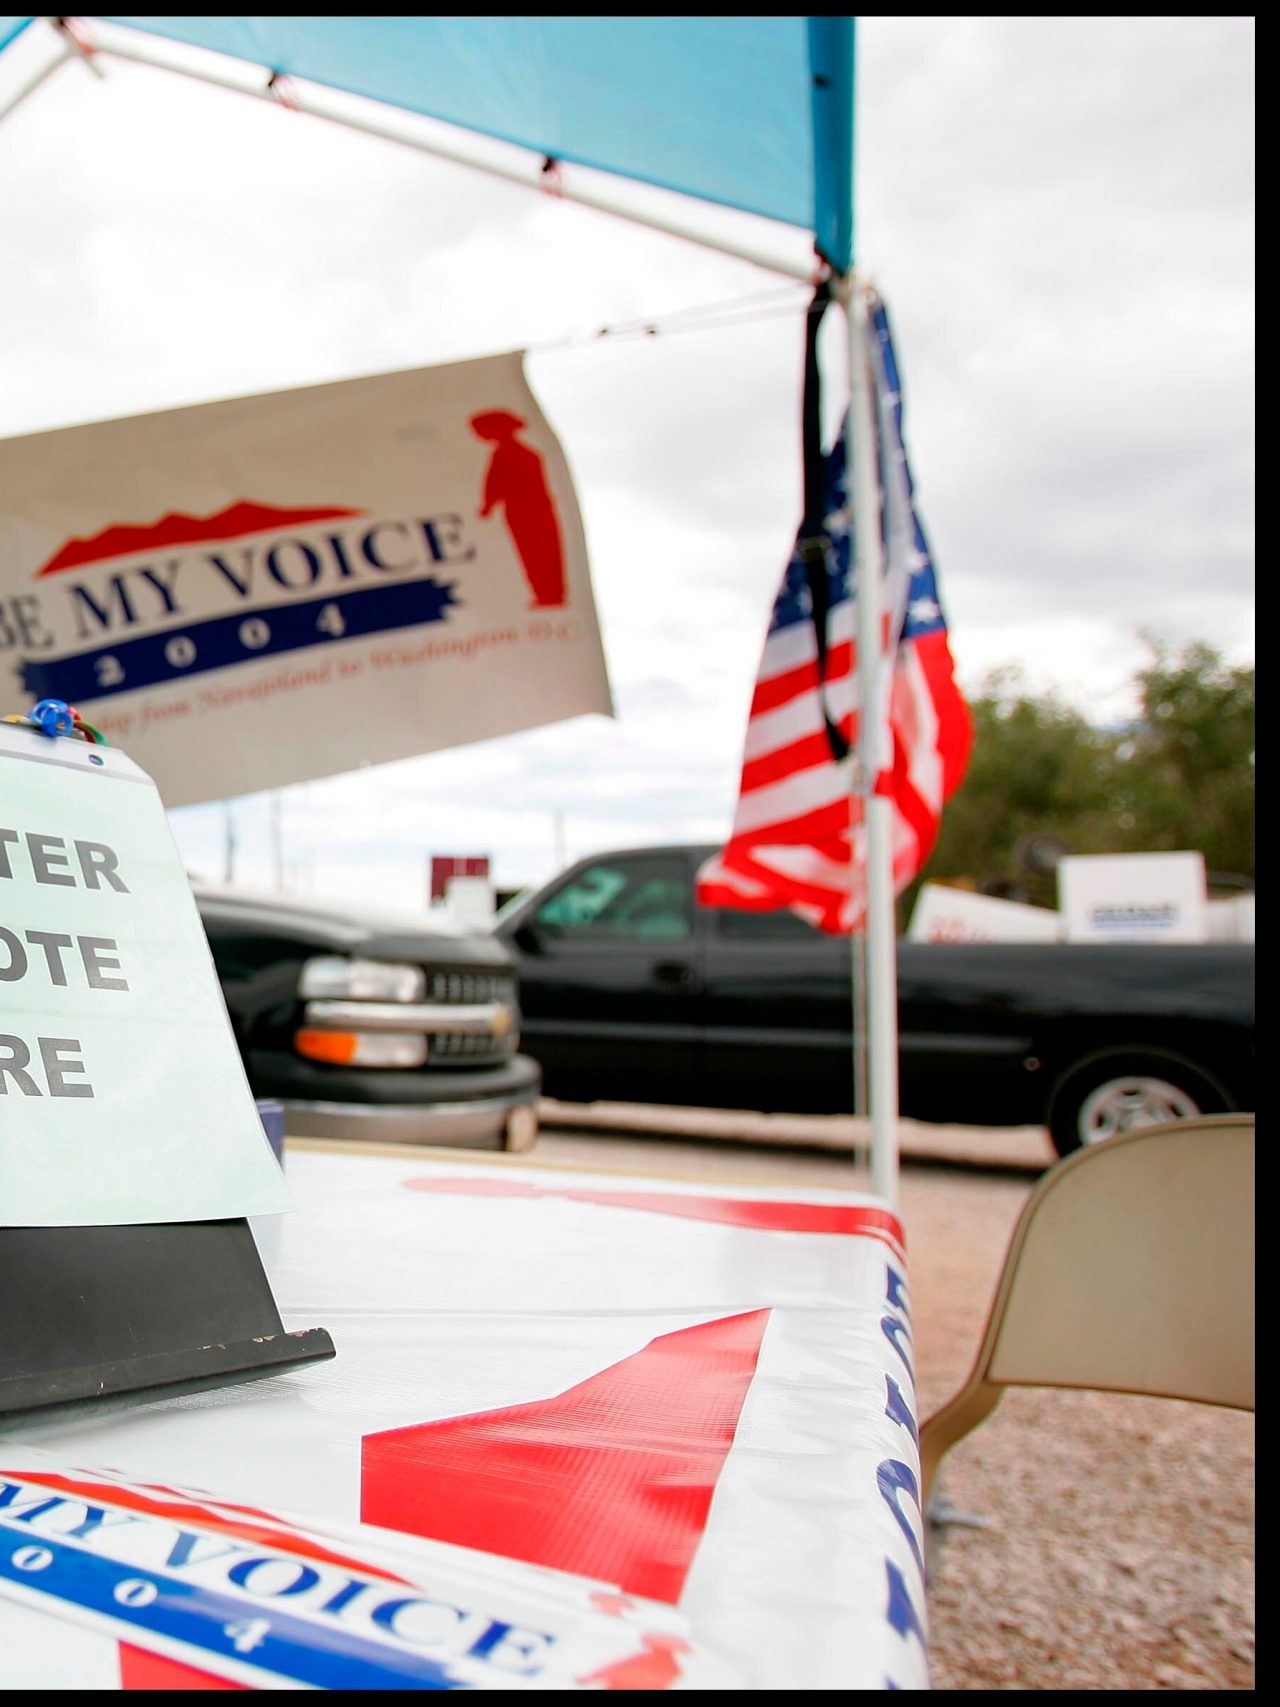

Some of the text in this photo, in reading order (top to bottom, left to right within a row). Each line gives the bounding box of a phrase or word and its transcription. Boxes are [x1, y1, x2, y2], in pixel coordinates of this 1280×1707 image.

[68, 561, 180, 639] MY
[207, 512, 477, 599] VOICE
[164, 1528, 557, 1677] VOICE
